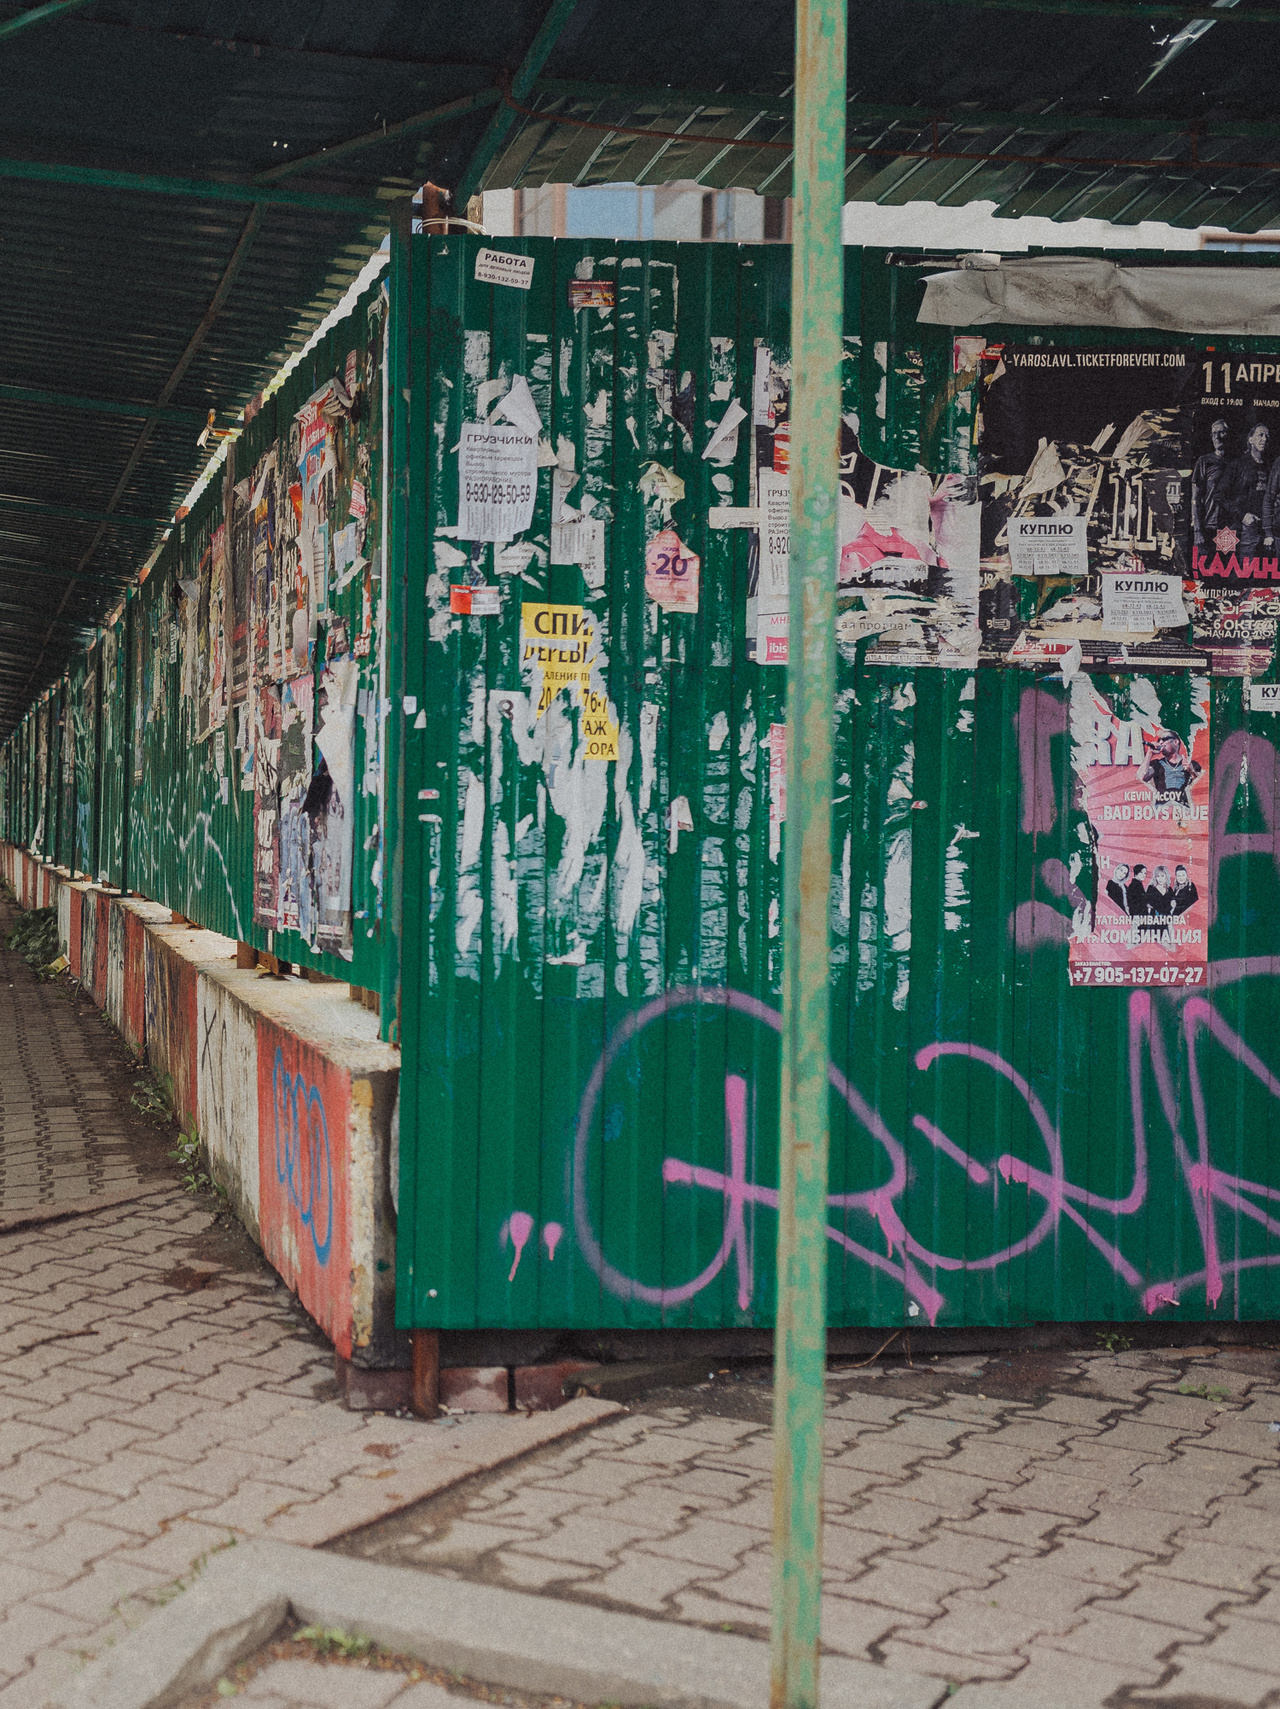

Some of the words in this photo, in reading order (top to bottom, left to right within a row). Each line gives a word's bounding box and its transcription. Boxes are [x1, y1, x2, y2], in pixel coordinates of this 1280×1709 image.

[485, 253, 527, 268] РАБОТА
[1201, 397, 1219, 406] ВХОД
[1226, 398, 1243, 406] 19:00
[1253, 399, 1280, 408] НАЧАЛО
[466, 434, 533, 445] ГРУЗЧИКИ
[466, 482, 531, 504] 8-930-129-50-59
[1020, 524, 1074, 535] КУПЛЮ
[1115, 580, 1169, 593] КУПЛЮ
[534, 611, 594, 637] СПИ
[769, 642, 788, 654] ibis
[1262, 687, 1280, 698] КУ
[1124, 791, 1151, 801] KEVIN
[1153, 791, 1182, 801] McCOY
[1103, 805, 1133, 821] BAD
[1133, 805, 1171, 821] BOYS
[1173, 805, 1209, 821] BLUE
[1095, 915, 1140, 926] ТАТЬЯНА
[1139, 914, 1187, 926] ИВАНОВА
[1100, 929, 1202, 946] КОМБИНАЦИЯ
[1073, 967, 1092, 983] +7
[1094, 967, 1204, 984] 905-137-07-27
